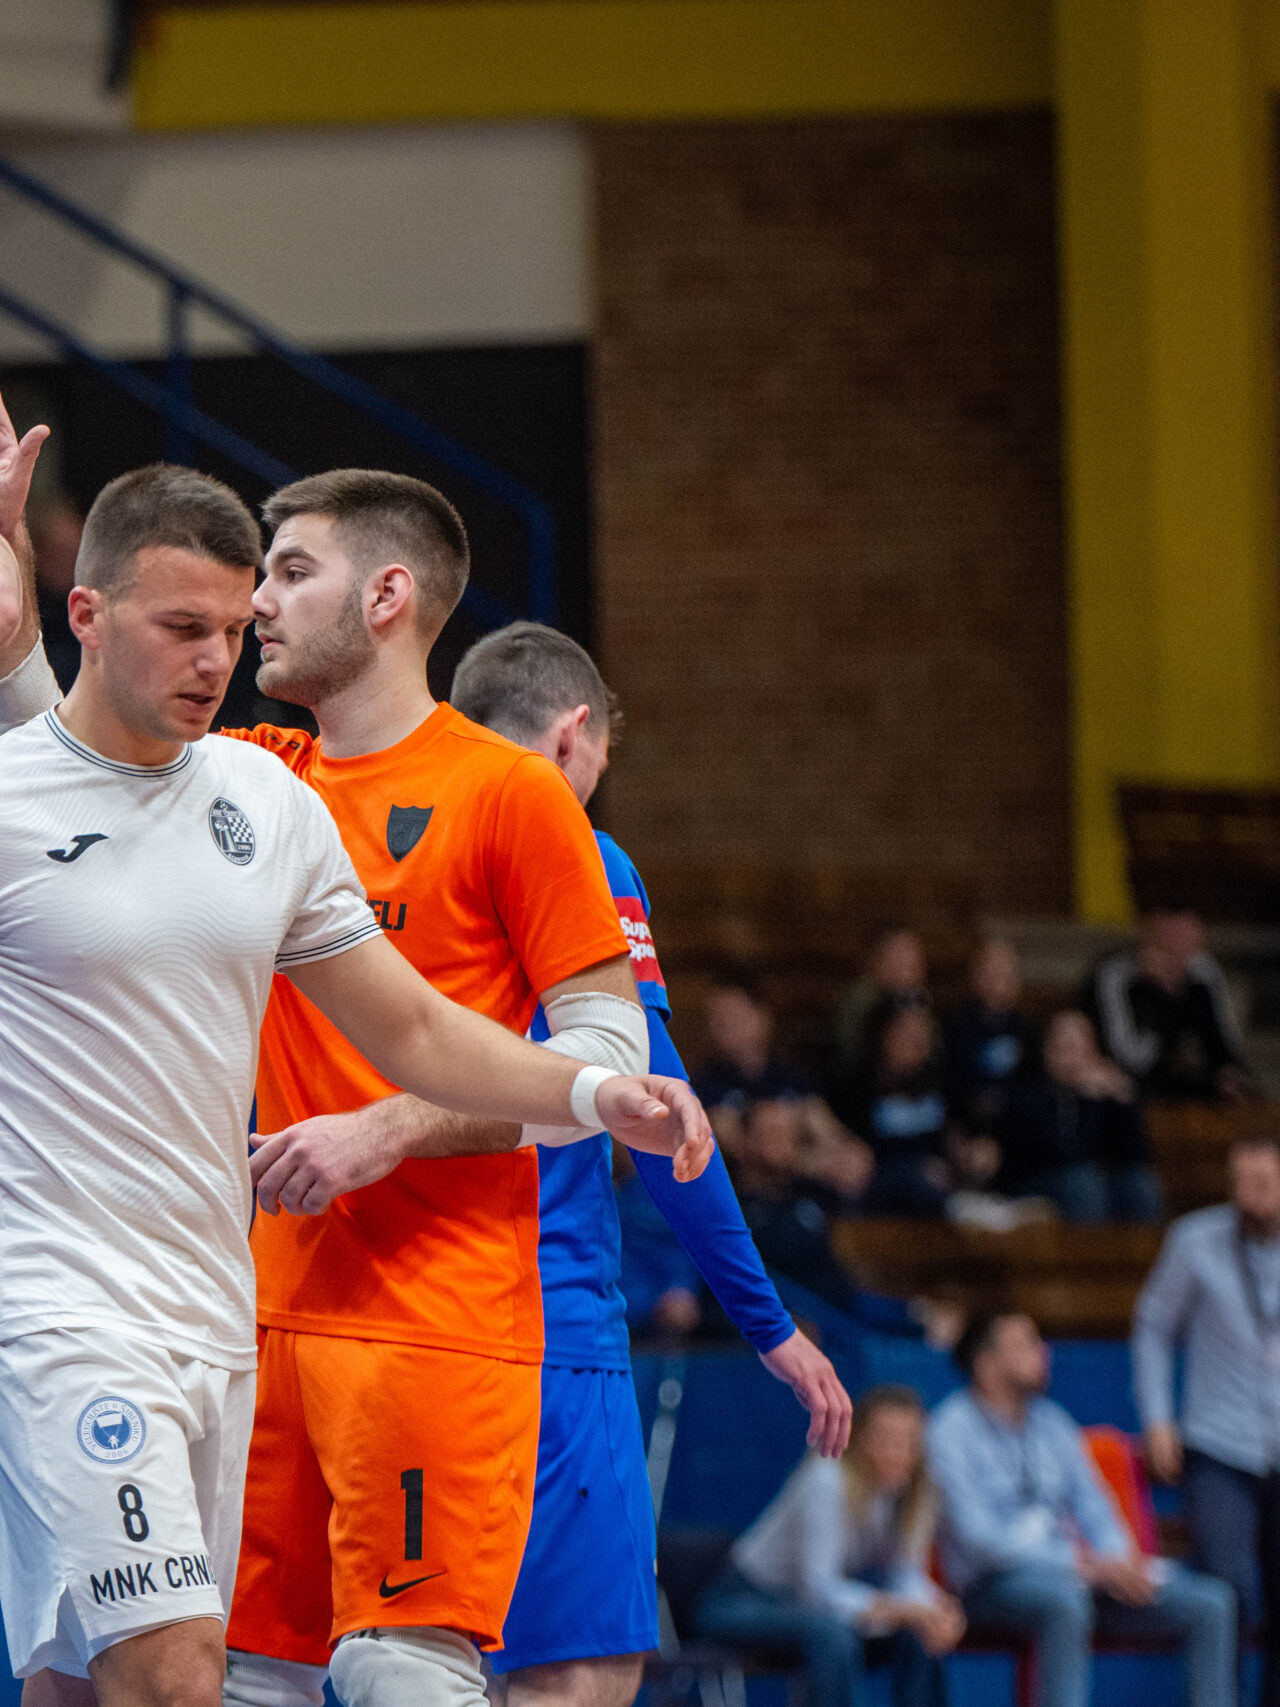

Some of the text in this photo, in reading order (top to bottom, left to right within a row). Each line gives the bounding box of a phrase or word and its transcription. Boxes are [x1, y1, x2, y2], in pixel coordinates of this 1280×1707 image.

[117, 1483, 150, 1543] 8
[401, 1468, 424, 1561] 1
[89, 1554, 217, 1605] MNK CRN
